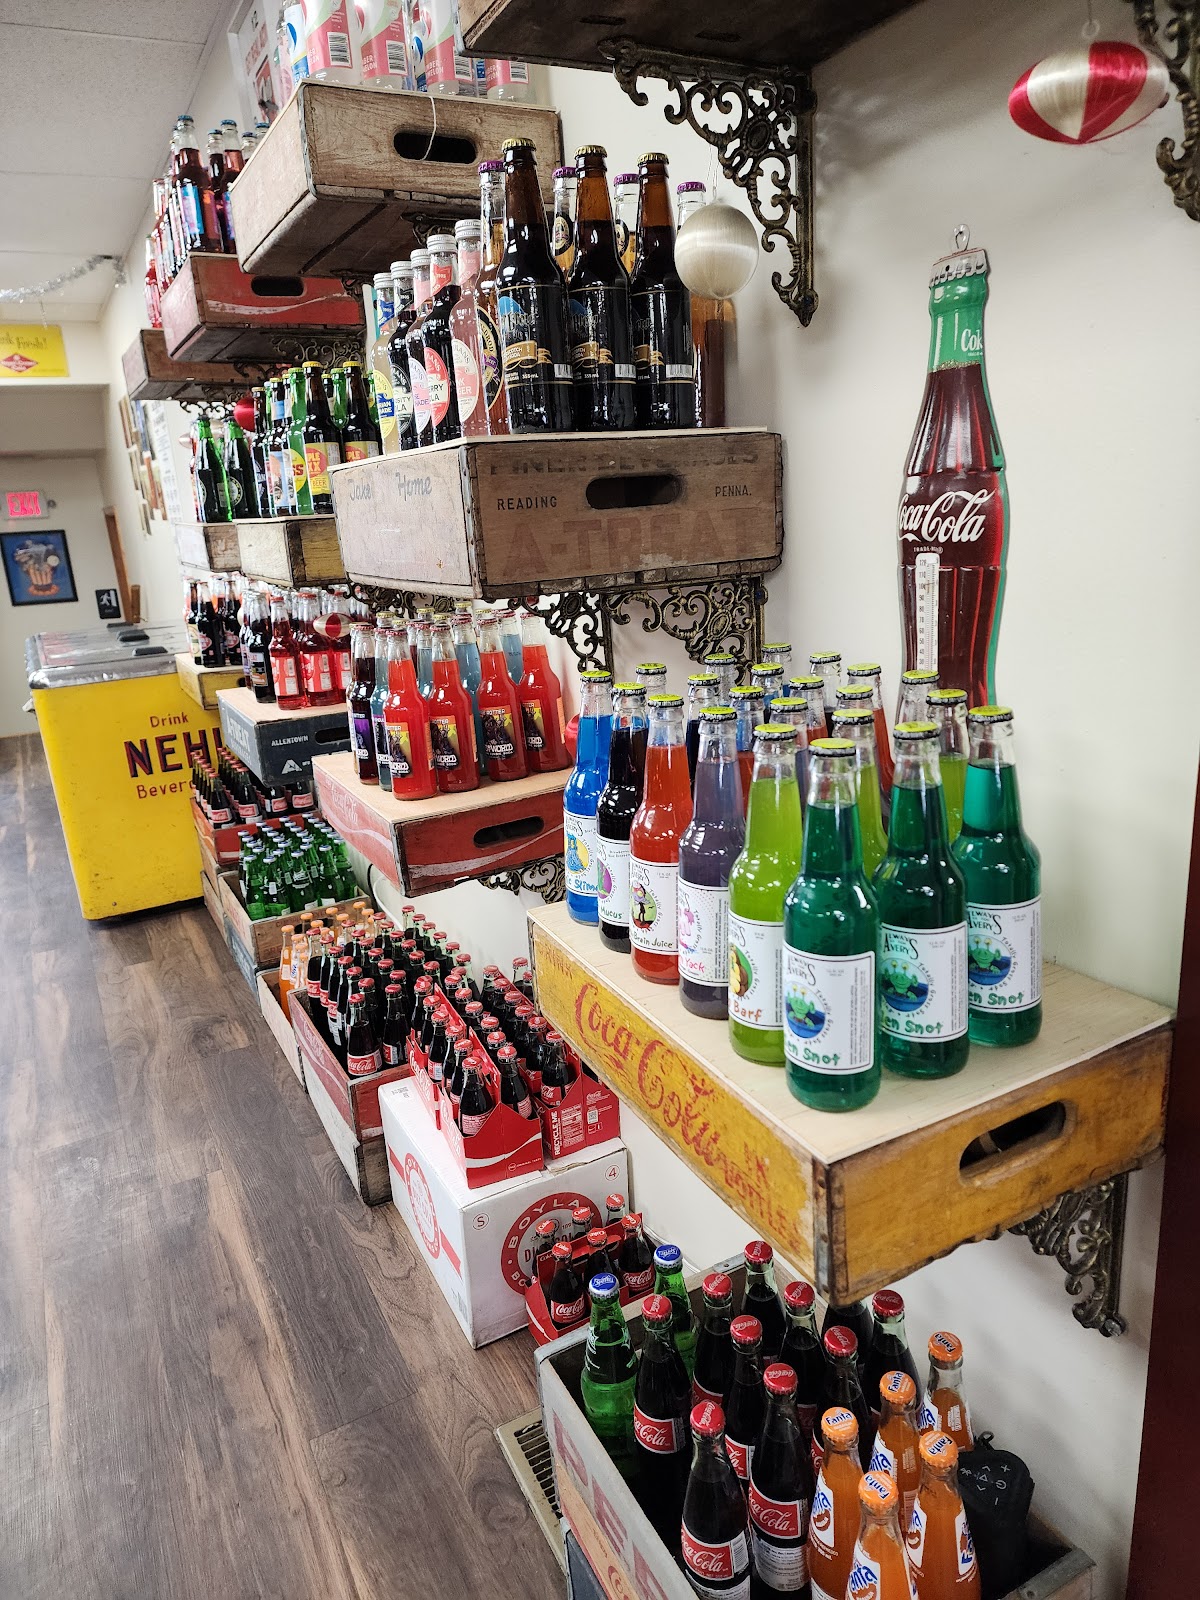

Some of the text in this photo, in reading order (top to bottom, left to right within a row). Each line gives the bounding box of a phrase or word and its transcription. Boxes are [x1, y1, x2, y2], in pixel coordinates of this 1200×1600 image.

[961, 328, 984, 352] Cok
[396, 472, 433, 498] Home
[497, 485, 753, 511] READING PENNA.
[502, 507, 759, 577] A-TREAT
[149, 711, 189, 729] Drink
[271, 735, 309, 747] ALLENTOWN
[651, 937, 673, 949] Juice
[685, 958, 706, 974] Yack
[987, 990, 1025, 1007] Snot
[733, 999, 763, 1023] Barf
[904, 1019, 944, 1035] Snot
[802, 1046, 841, 1067] Snot
[551, 1110, 561, 1156] RECYCLE ME
[608, 1166, 618, 1179] 4
[476, 1215, 485, 1228] S
[555, 1242, 570, 1252] Coke
[887, 1371, 904, 1393] Fanta
[825, 1411, 854, 1426] Fanta
